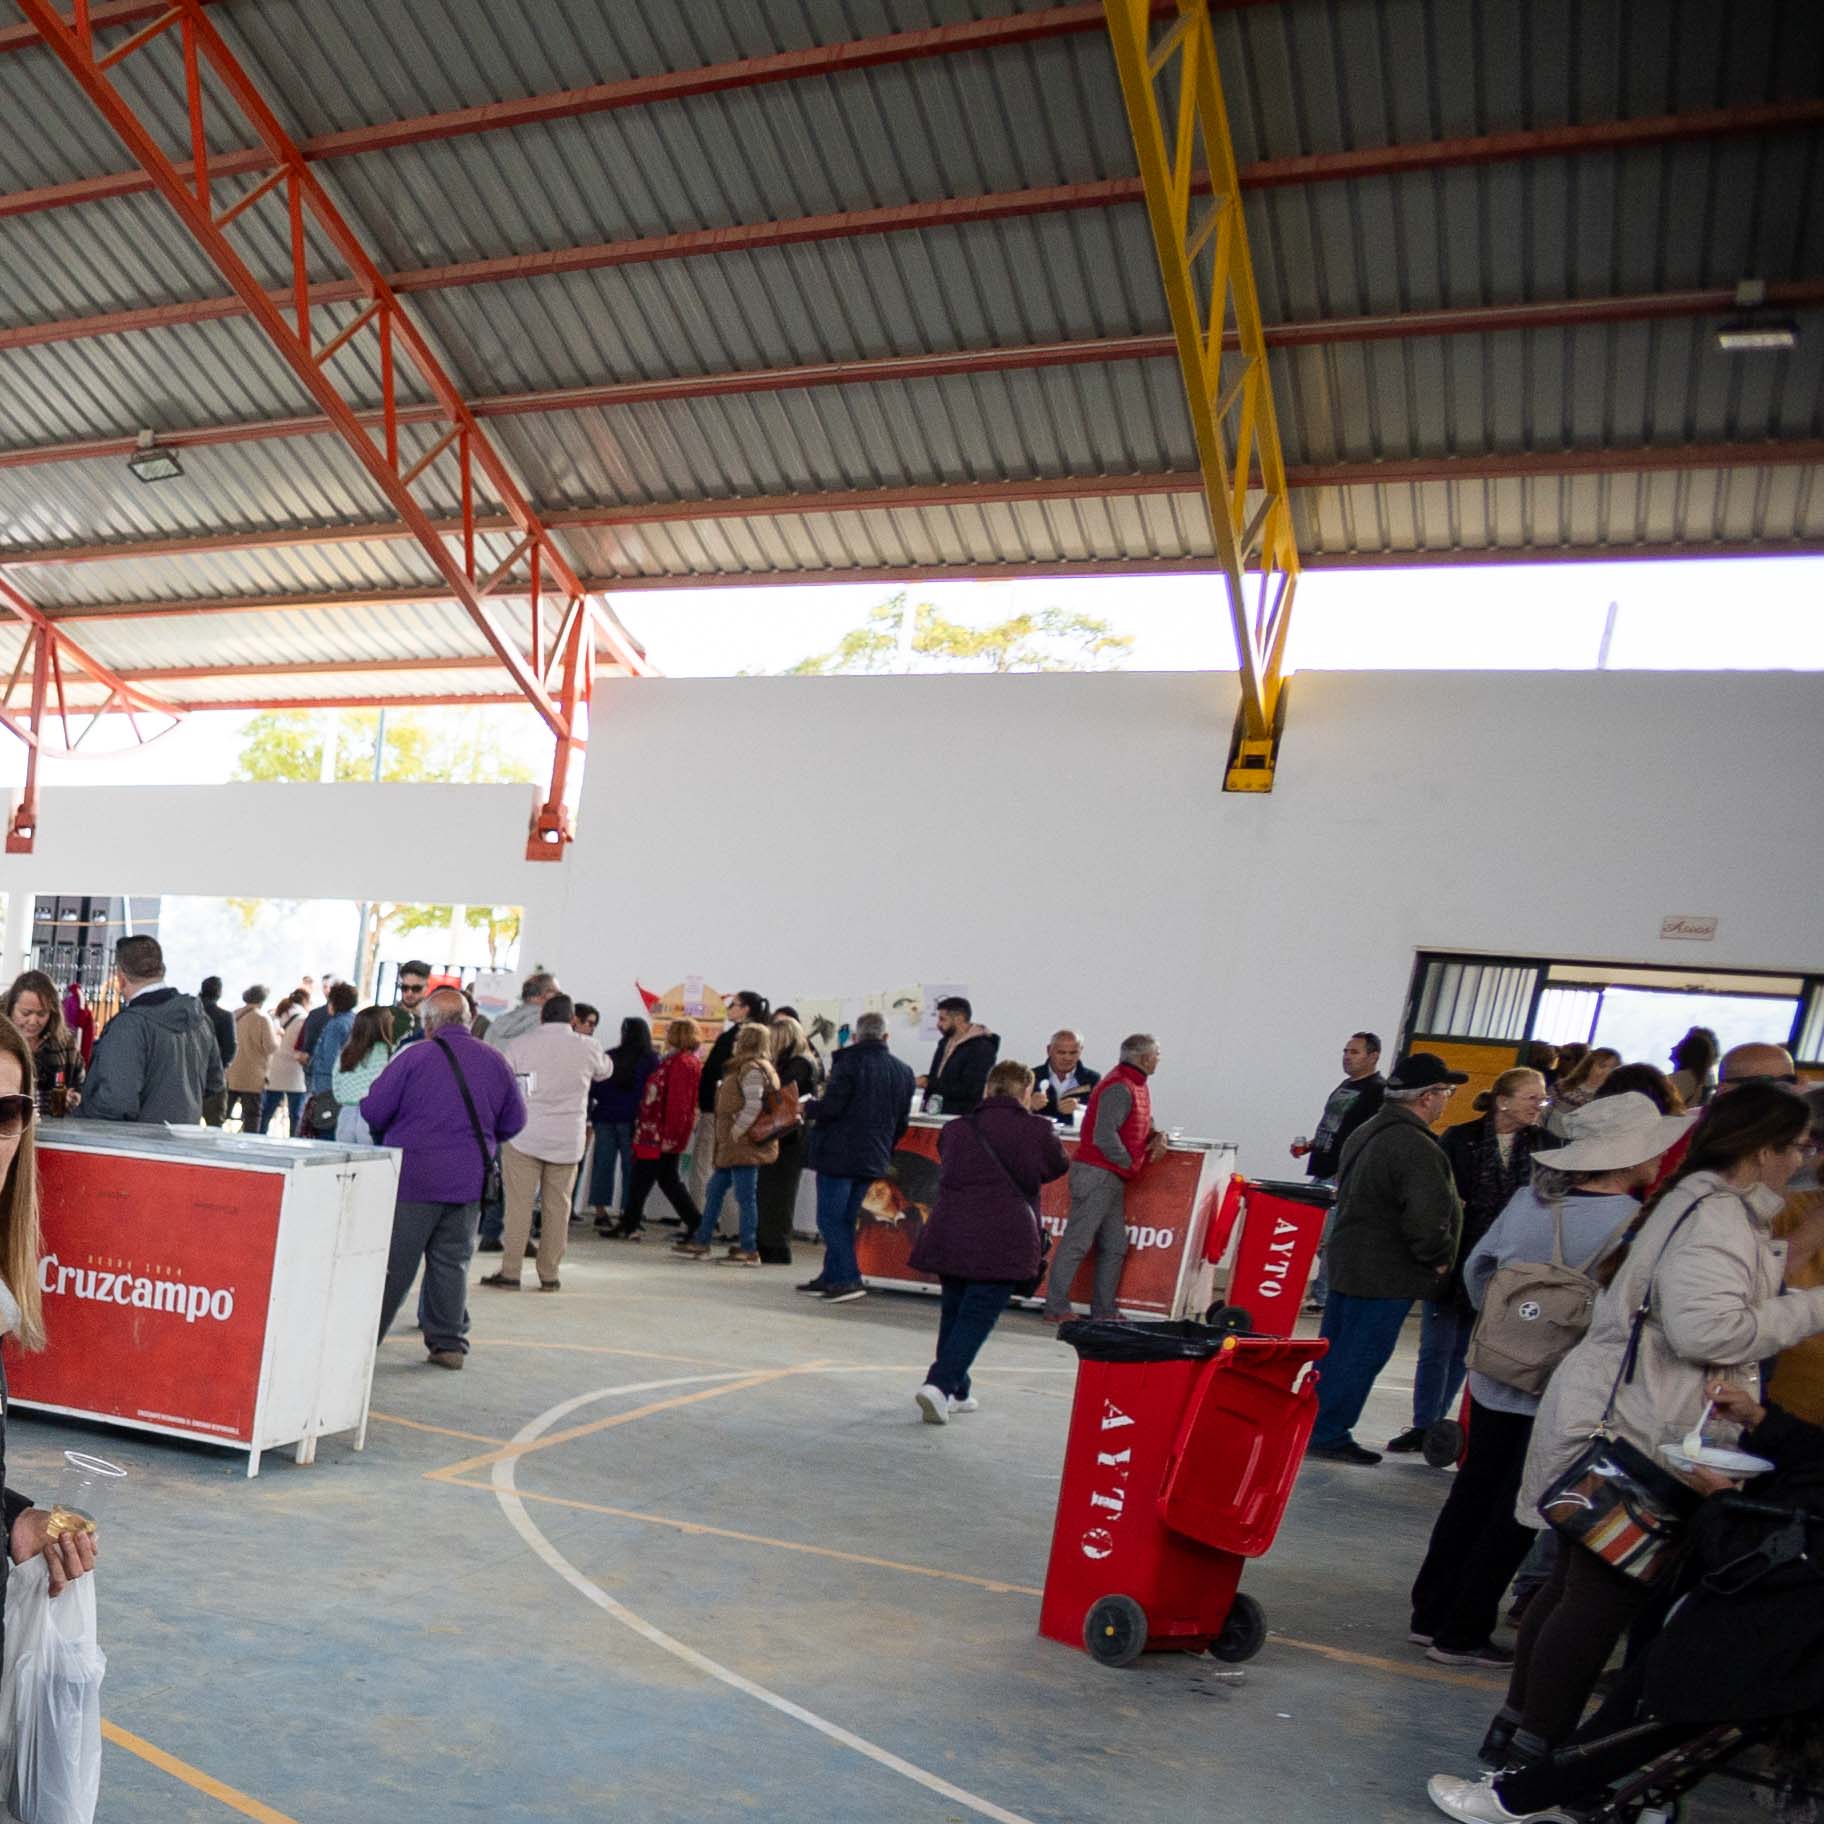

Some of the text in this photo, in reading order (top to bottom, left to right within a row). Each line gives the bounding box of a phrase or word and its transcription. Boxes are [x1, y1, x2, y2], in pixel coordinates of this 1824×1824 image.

[39, 1253, 234, 1323] Cruzcampo
[1258, 1217, 1299, 1297] AYTO
[1081, 1398, 1135, 1559] AYTO
